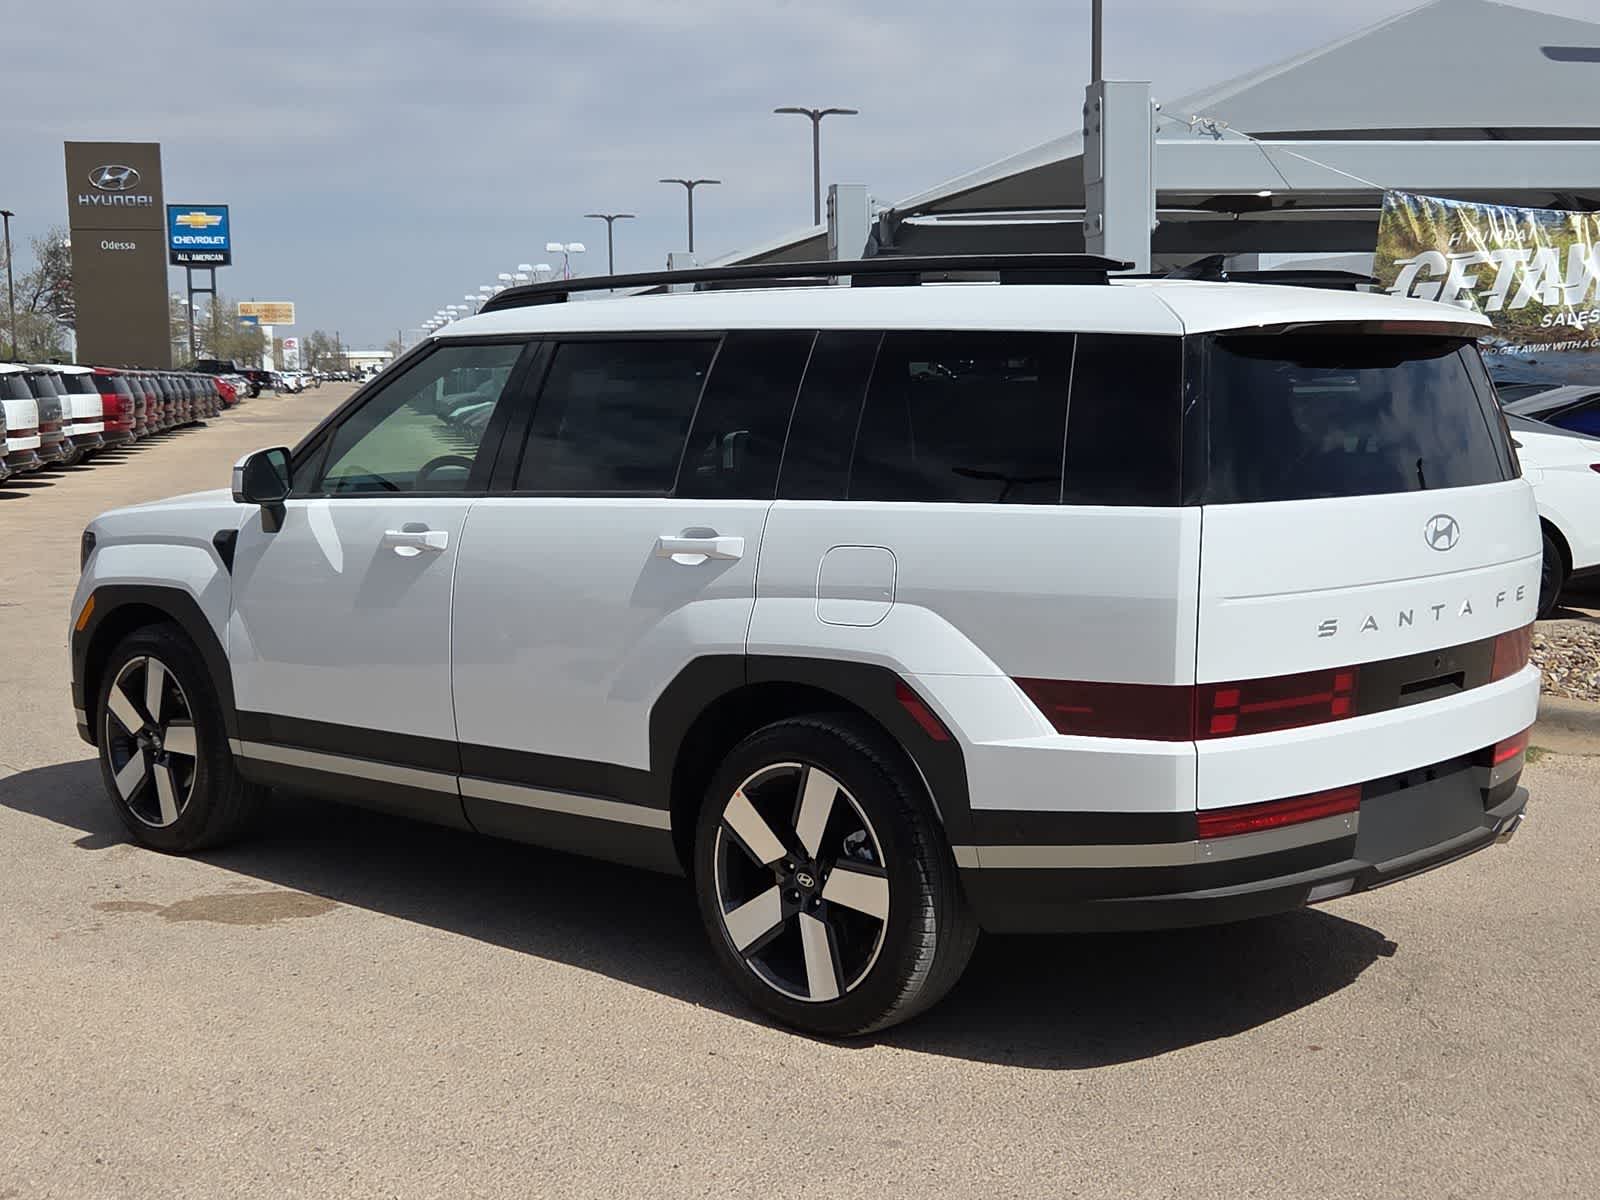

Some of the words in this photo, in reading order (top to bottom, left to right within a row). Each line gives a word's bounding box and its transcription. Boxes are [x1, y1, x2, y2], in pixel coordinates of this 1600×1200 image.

[78, 194, 153, 207] HYUNDAI
[101, 239, 136, 250] Odessa
[173, 235, 225, 245] CHEVROLET
[177, 253, 189, 262] ALL
[191, 253, 224, 262] AMERICAN
[1553, 340, 1580, 351] WITH
[1580, 339, 1590, 348] A
[1317, 600, 1473, 638] SANTA
[1495, 585, 1526, 608] FE
